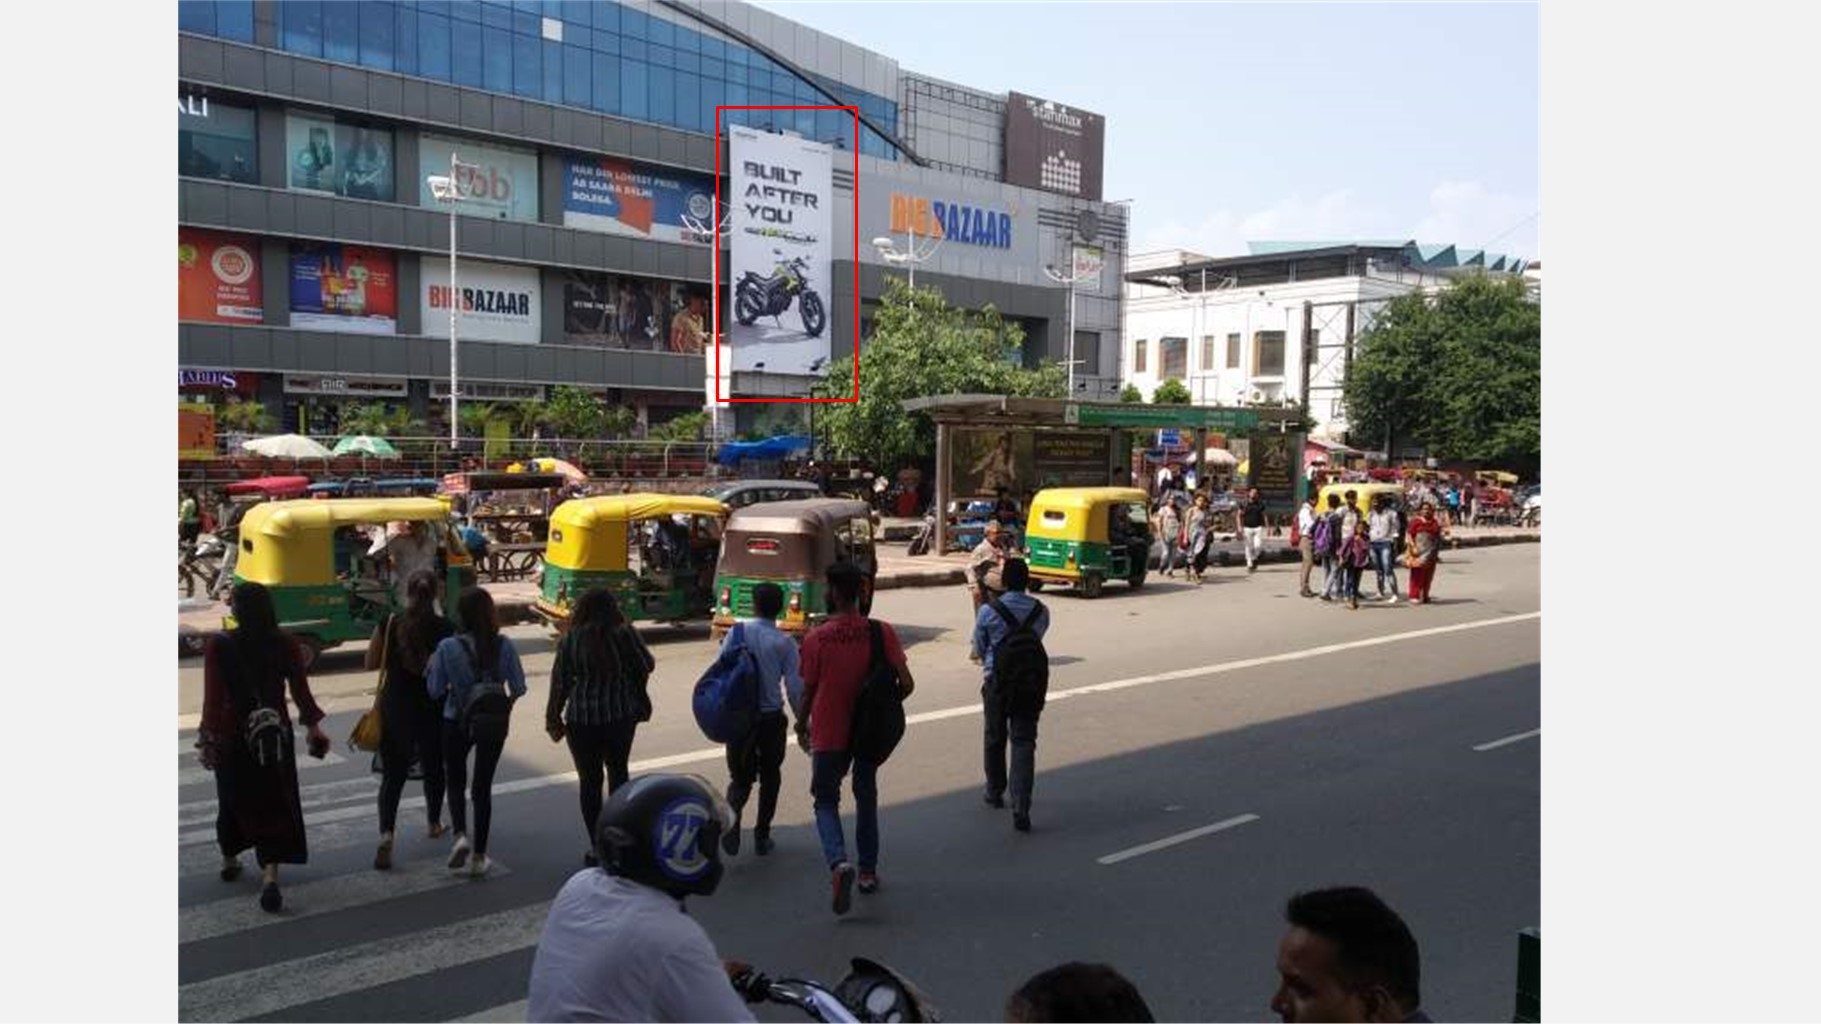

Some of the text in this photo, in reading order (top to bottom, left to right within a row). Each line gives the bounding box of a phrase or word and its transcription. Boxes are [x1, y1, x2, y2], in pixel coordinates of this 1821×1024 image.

[744, 161, 802, 186] BUILT
[745, 183, 818, 209] AFTER
[745, 203, 793, 224] YOU
[889, 194, 1012, 249] BIG BAZAAR
[429, 284, 530, 316] BIG BAZAAR
